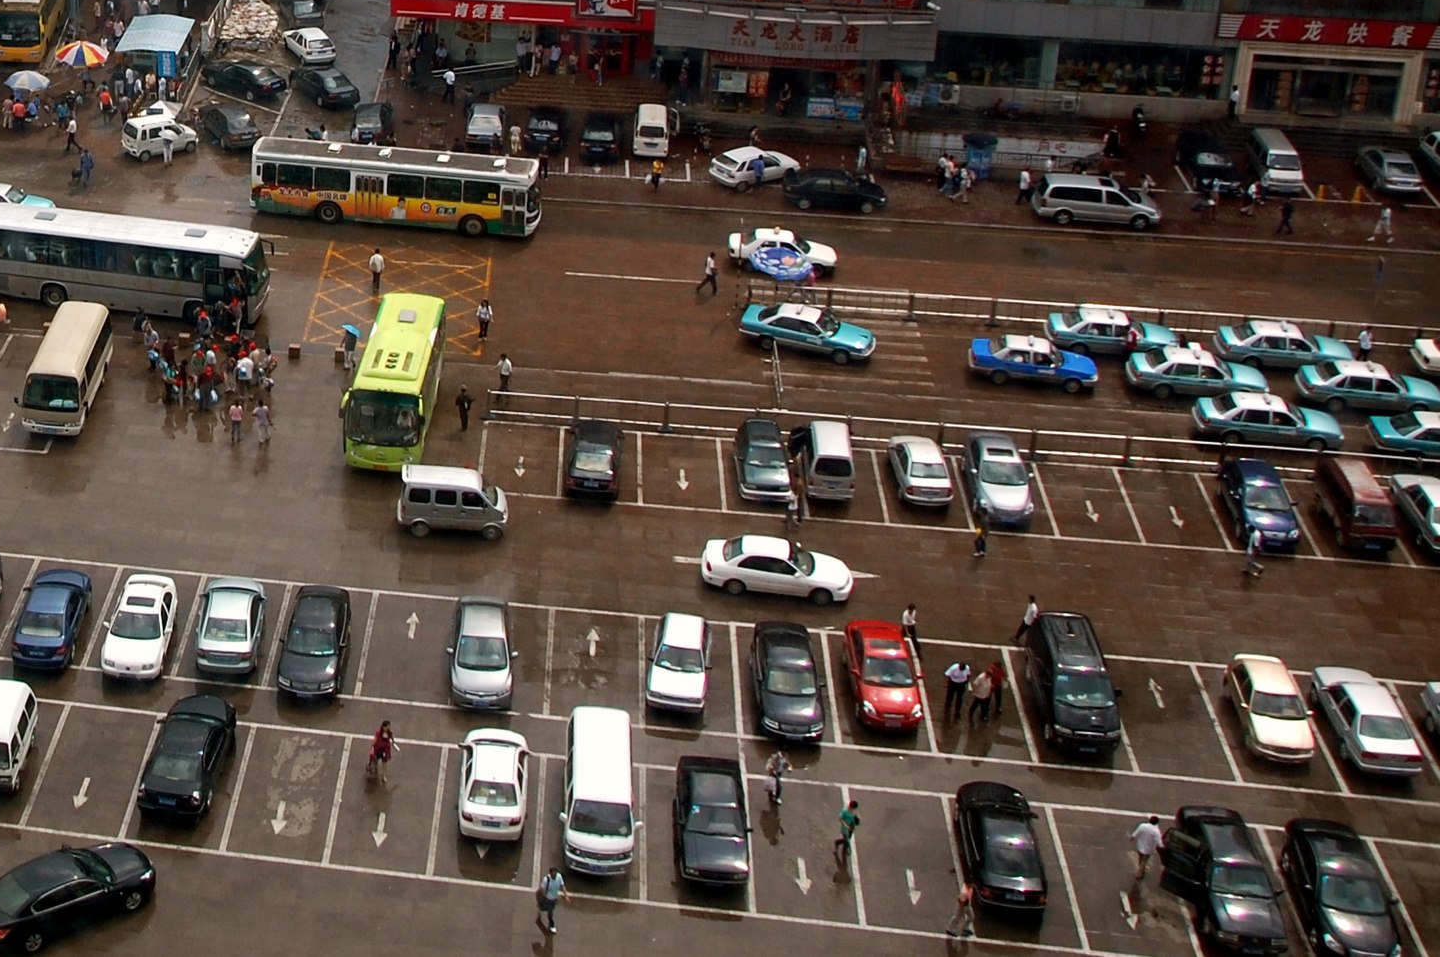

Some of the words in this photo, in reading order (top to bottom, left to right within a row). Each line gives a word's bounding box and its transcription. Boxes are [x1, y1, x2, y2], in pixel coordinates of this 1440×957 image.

[454, 2, 506, 20] 肯德基
[732, 18, 861, 44] 天龙大酒店
[1256, 18, 1415, 47] 天龙快餐
[774, 41, 805, 51] LONG
